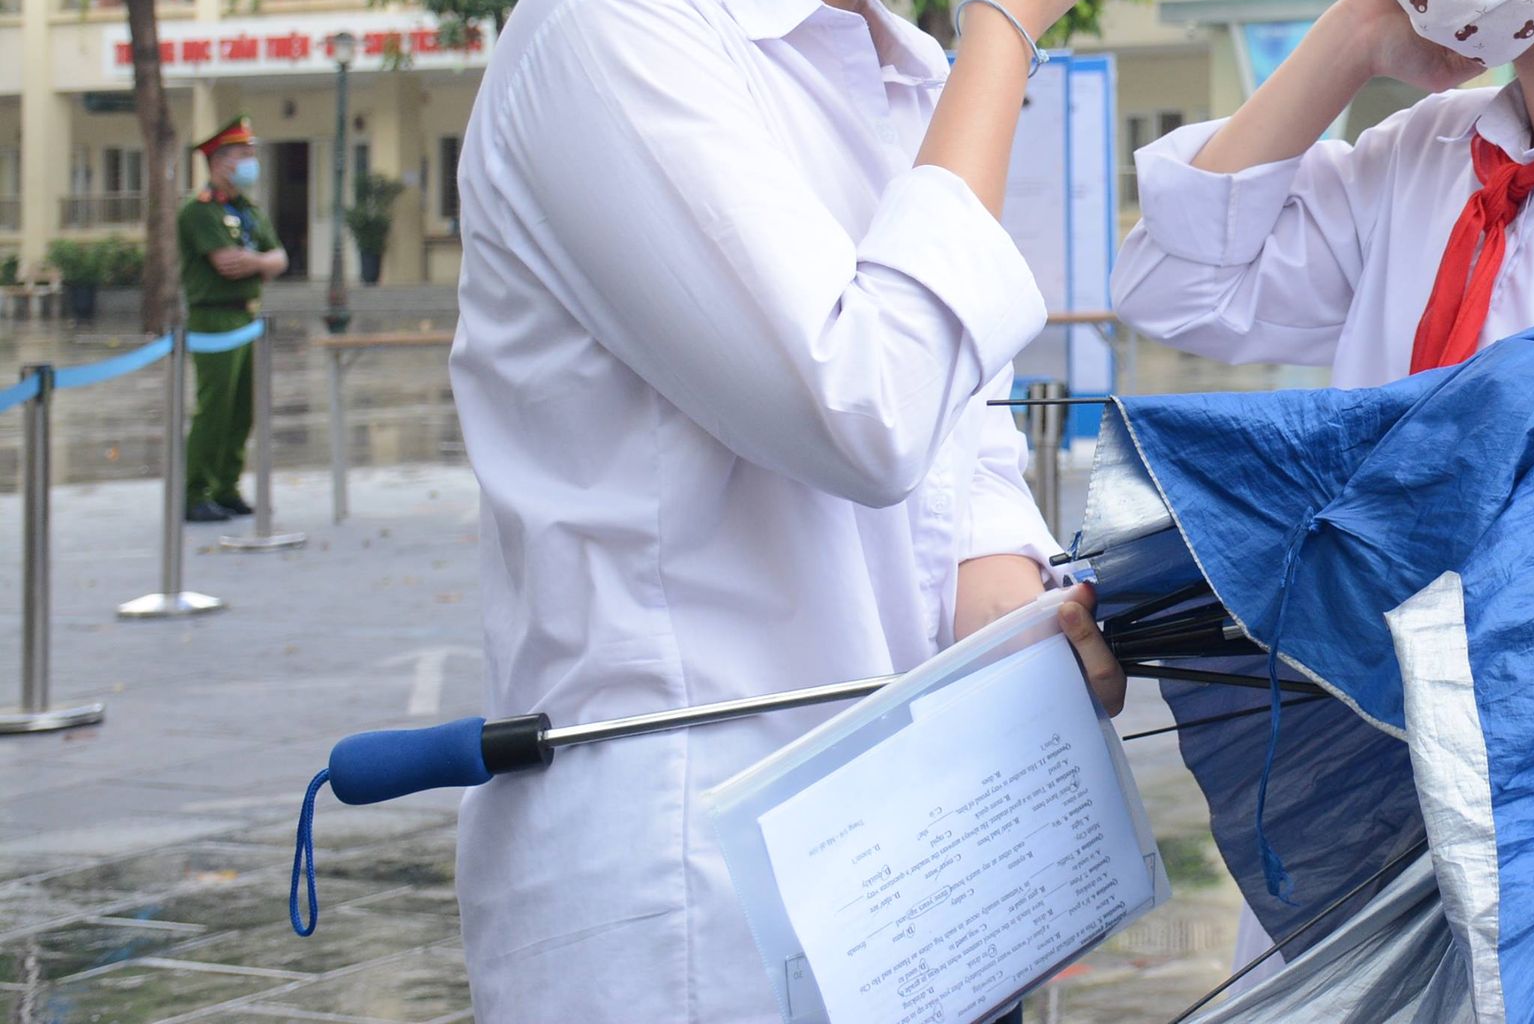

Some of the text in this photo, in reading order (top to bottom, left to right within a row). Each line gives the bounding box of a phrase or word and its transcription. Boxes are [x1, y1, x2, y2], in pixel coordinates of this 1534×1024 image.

[1046, 741, 1070, 761] Question
[1048, 761, 1060, 774] good
[1055, 764, 1079, 784] Question
[991, 783, 1001, 793] very
[974, 790, 990, 804] proud
[1046, 793, 1057, 804] have
[934, 806, 942, 815] C.
[1009, 799, 1021, 812] good
[1068, 798, 1091, 818] Question
[944, 829, 951, 838] C.
[961, 826, 979, 842] always
[990, 829, 1000, 839] had
[930, 833, 943, 847] rapid
[1081, 832, 1103, 852] Question
[940, 839, 959, 854] answers
[931, 851, 939, 861] the
[954, 853, 961, 862] C.
[1089, 855, 1110, 875] Question
[880, 871, 904, 892] questions
[1096, 878, 1117, 897] Question
[892, 891, 899, 900] D.
[967, 888, 974, 897] C.
[1001, 885, 1022, 903] Vietnam
[918, 897, 932, 910] years
[981, 898, 999, 915] usually
[1068, 902, 1080, 916] good
[1103, 900, 1125, 920] Question
[1033, 913, 1045, 925] drink
[944, 927, 956, 939] such
[980, 923, 986, 932] C.
[1001, 922, 1009, 932] the
[1086, 922, 1095, 932] This
[934, 935, 943, 946] big
[984, 928, 1000, 943] school
[847, 941, 866, 957] friends
[893, 957, 910, 972] Hanoi
[968, 956, 980, 968] drink
[882, 969, 891, 979] and
[964, 959, 995, 984] immediately
[996, 970, 1003, 979] C.
[1017, 967, 1028, 979] wish
[871, 976, 880, 986] Ho
[905, 979, 920, 994] grade
[951, 981, 963, 993] after
[859, 982, 870, 993] Chi
[926, 986, 933, 995] D.
[903, 990, 925, 1010] drinking
[977, 995, 985, 1005] the
